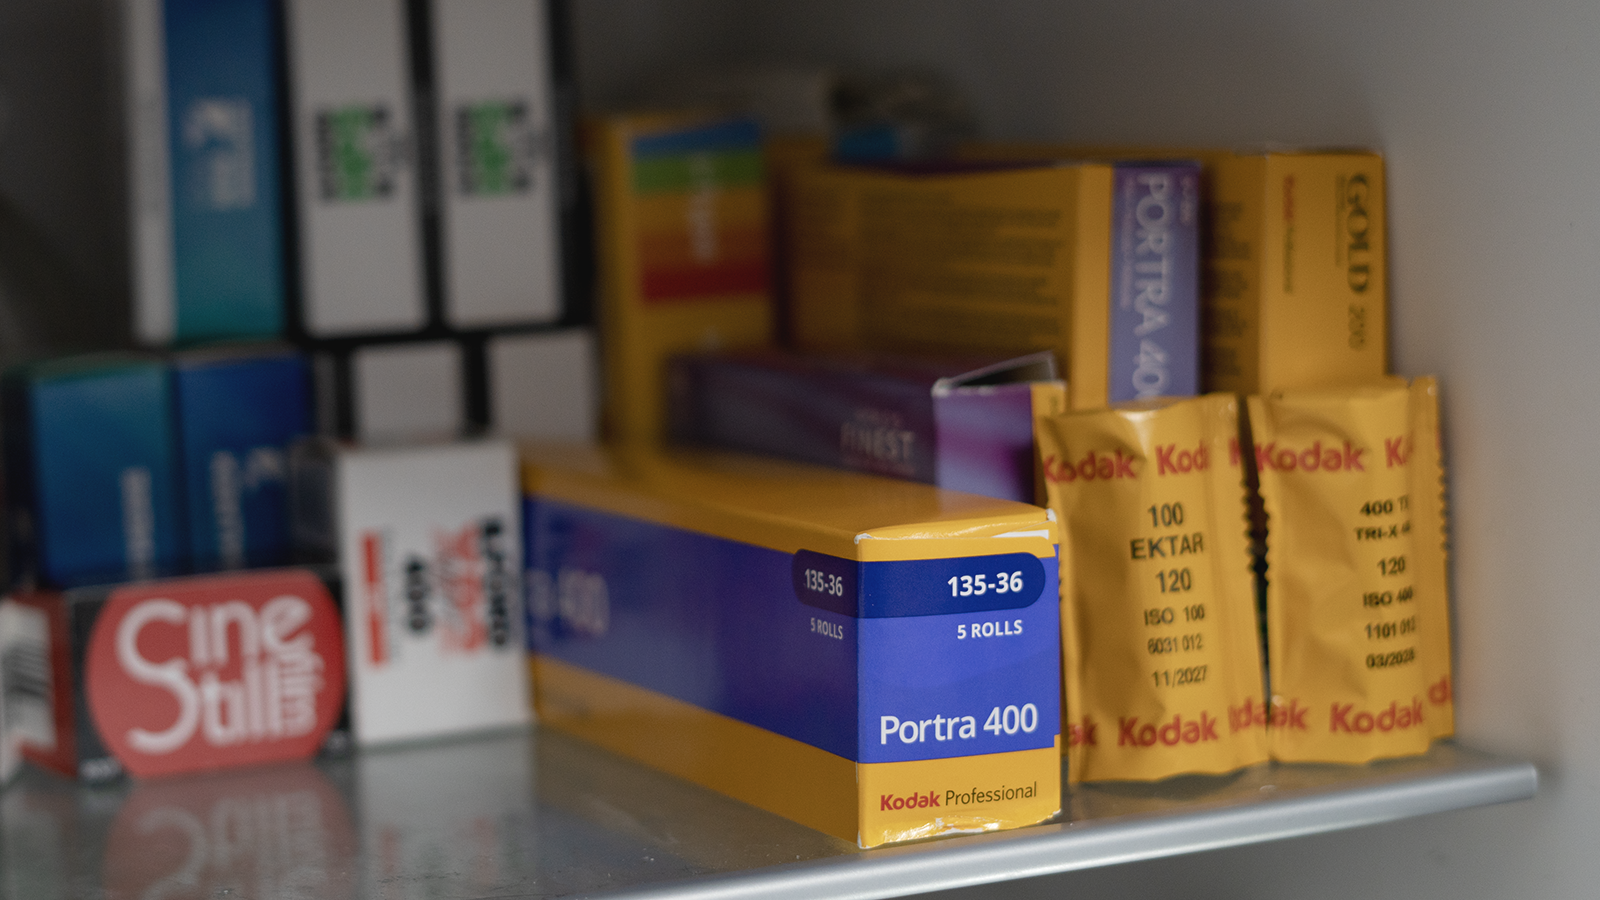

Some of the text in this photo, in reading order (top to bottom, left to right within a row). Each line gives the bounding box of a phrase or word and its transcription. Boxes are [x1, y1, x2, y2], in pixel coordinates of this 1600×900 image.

[1347, 174, 1371, 293] GOLD
[1134, 174, 1172, 335] PORTRA
[1255, 440, 1364, 474] Kodak
[1148, 502, 1184, 528] 100
[1360, 500, 1393, 517] 400
[1354, 524, 1397, 542] TRI-X
[1130, 532, 1204, 560] EKTAR
[1377, 556, 1406, 577] 120
[804, 568, 843, 596] 135-36
[948, 571, 1023, 597] 135-36
[1155, 568, 1192, 593] 120
[1363, 592, 1393, 608] ISO
[1144, 604, 1205, 626] ISO 100
[810, 617, 843, 640] 5 ROLLS
[957, 619, 1023, 639] 5 ROLLS
[1364, 622, 1397, 640] 1101
[1182, 633, 1203, 651] 012
[1152, 665, 1207, 688] 11/2027
[880, 703, 1038, 745] Portra 400
[1329, 696, 1425, 733] Kodak
[1118, 711, 1219, 747] Kodak
[880, 781, 1037, 811] Kodak Professional
